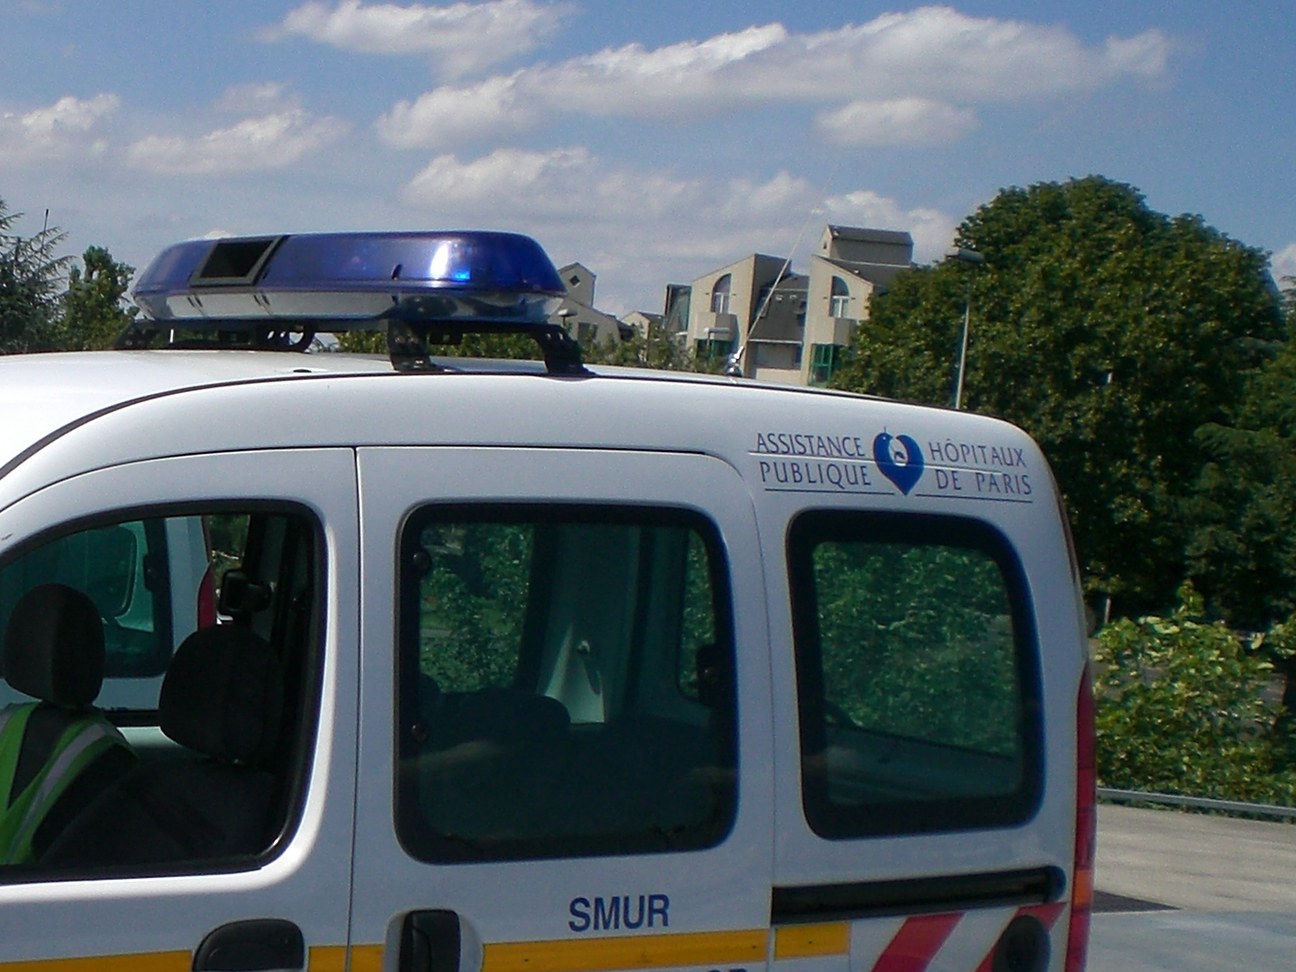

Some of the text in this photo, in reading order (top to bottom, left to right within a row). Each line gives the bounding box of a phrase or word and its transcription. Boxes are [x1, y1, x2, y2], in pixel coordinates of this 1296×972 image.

[756, 433, 866, 458] ASSISTANCE
[928, 438, 1028, 468] HÔPITAUX
[759, 461, 872, 489] PUBLIQUE
[935, 469, 1033, 495] DE PARIS
[568, 894, 671, 932] SMUR
